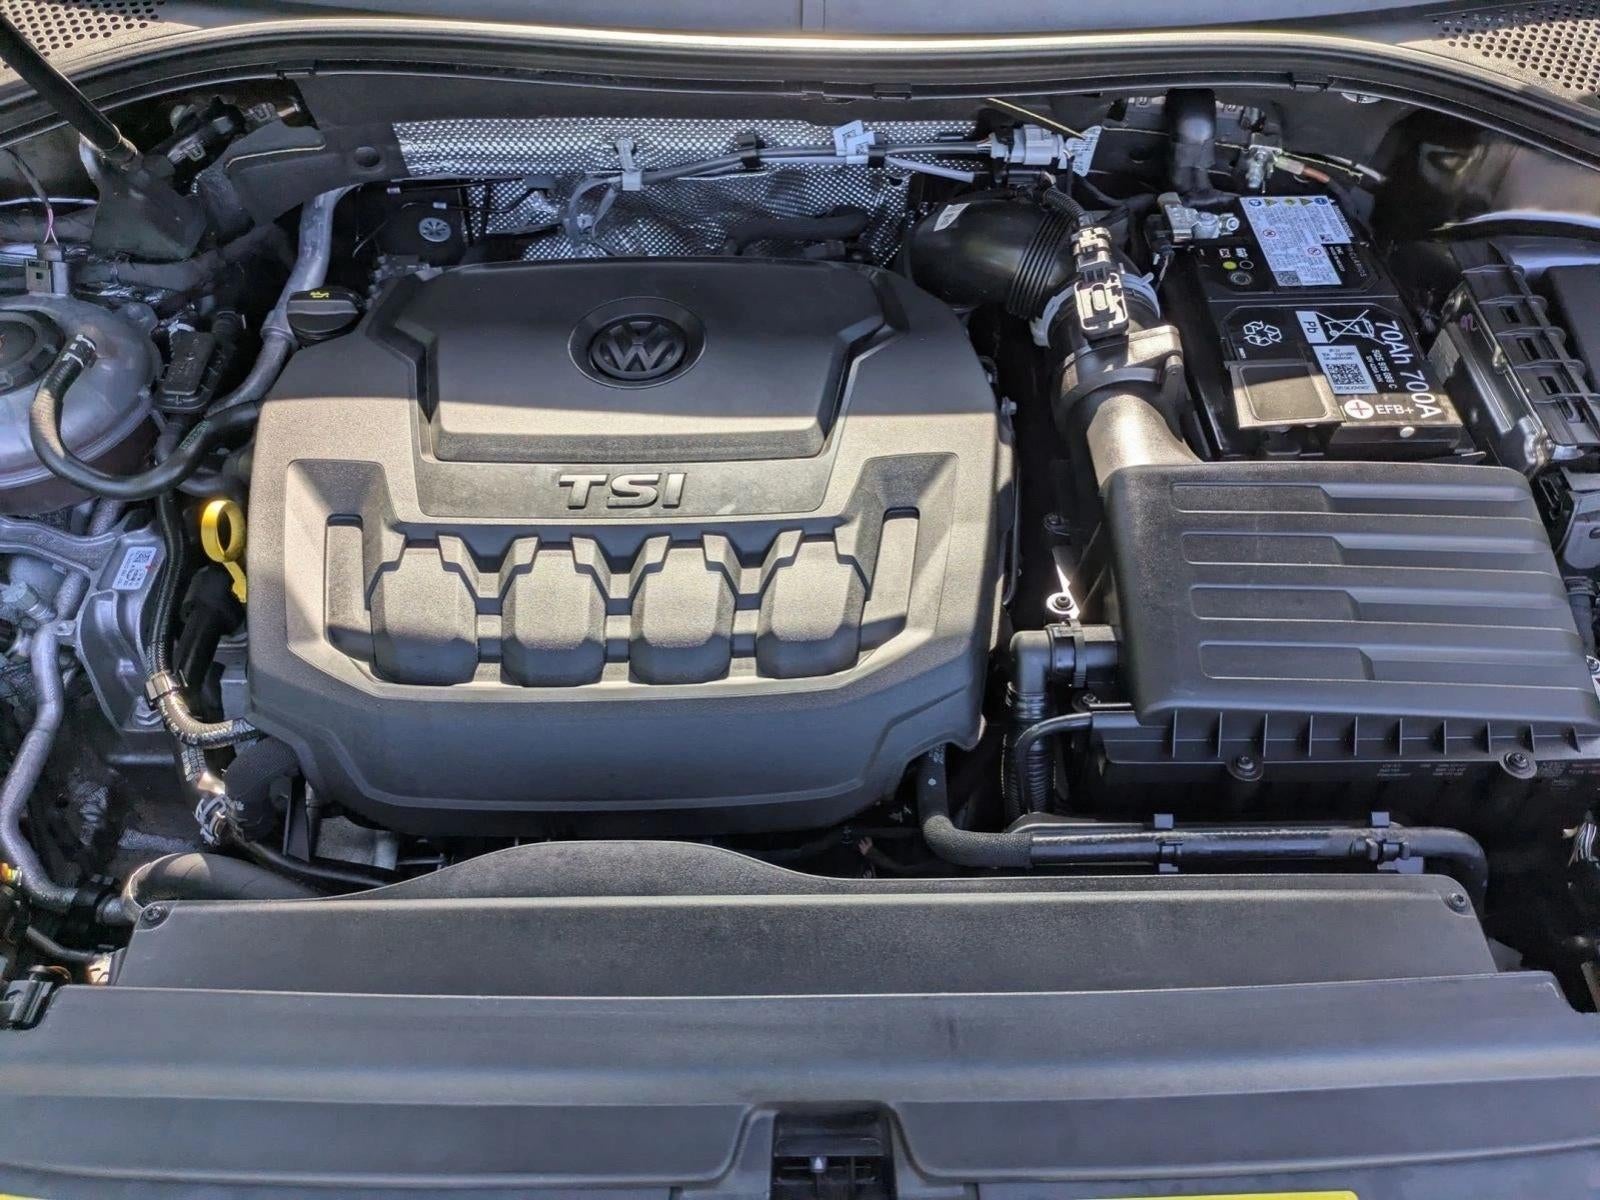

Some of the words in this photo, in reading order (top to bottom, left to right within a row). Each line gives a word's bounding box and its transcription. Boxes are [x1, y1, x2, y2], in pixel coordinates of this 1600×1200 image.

[1303, 321, 1319, 334] Pb
[591, 320, 687, 380] VW
[1375, 320, 1414, 364] 70Ah
[1400, 369, 1442, 419] 700A
[1375, 404, 1415, 415] EFB+
[558, 472, 687, 510] TSI
